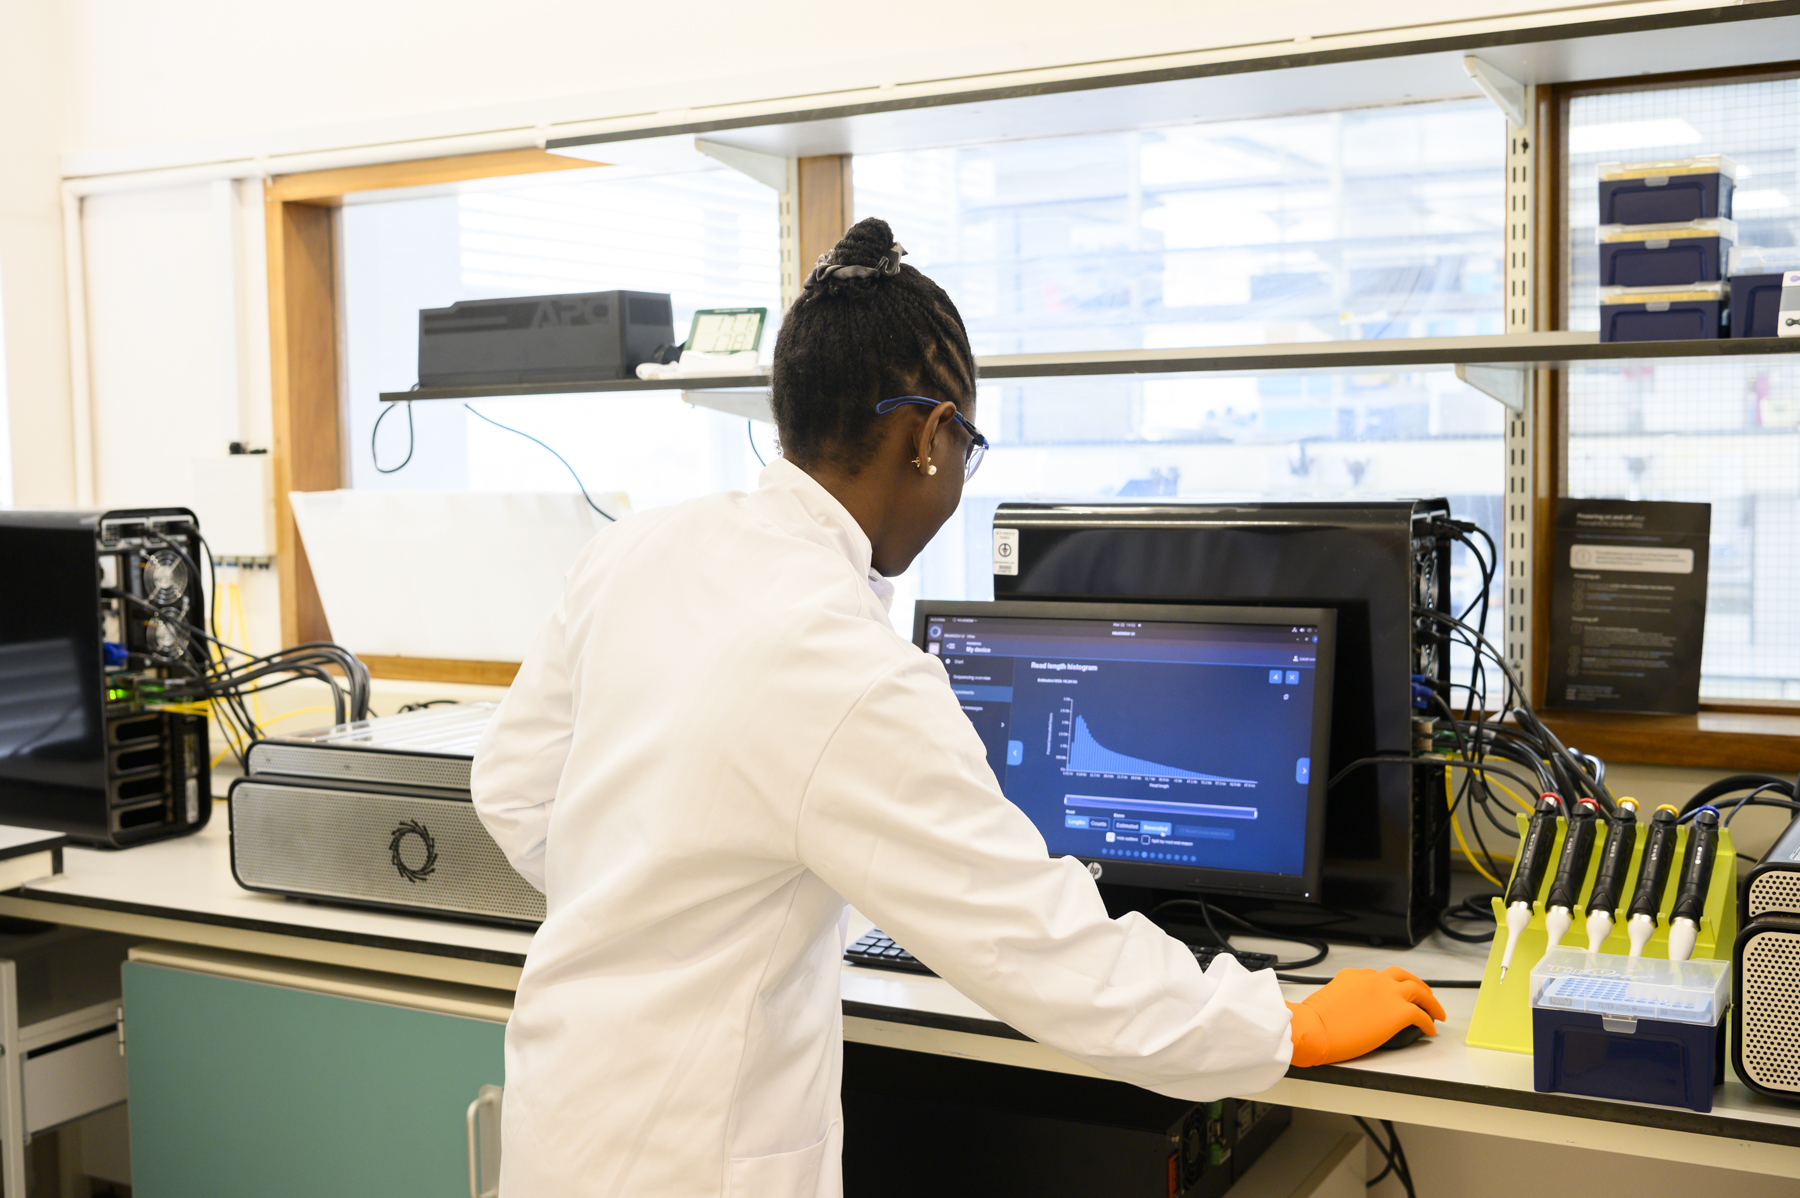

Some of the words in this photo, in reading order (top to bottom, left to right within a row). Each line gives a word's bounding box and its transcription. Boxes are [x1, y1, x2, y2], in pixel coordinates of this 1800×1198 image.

[966, 646, 974, 654] My
[1031, 661, 1047, 669] Read
[1047, 662, 1067, 671] length
[1067, 663, 1098, 672] histogram
[1116, 822, 1139, 830] Estimated
[1598, 1001, 1614, 1010] FILTER
